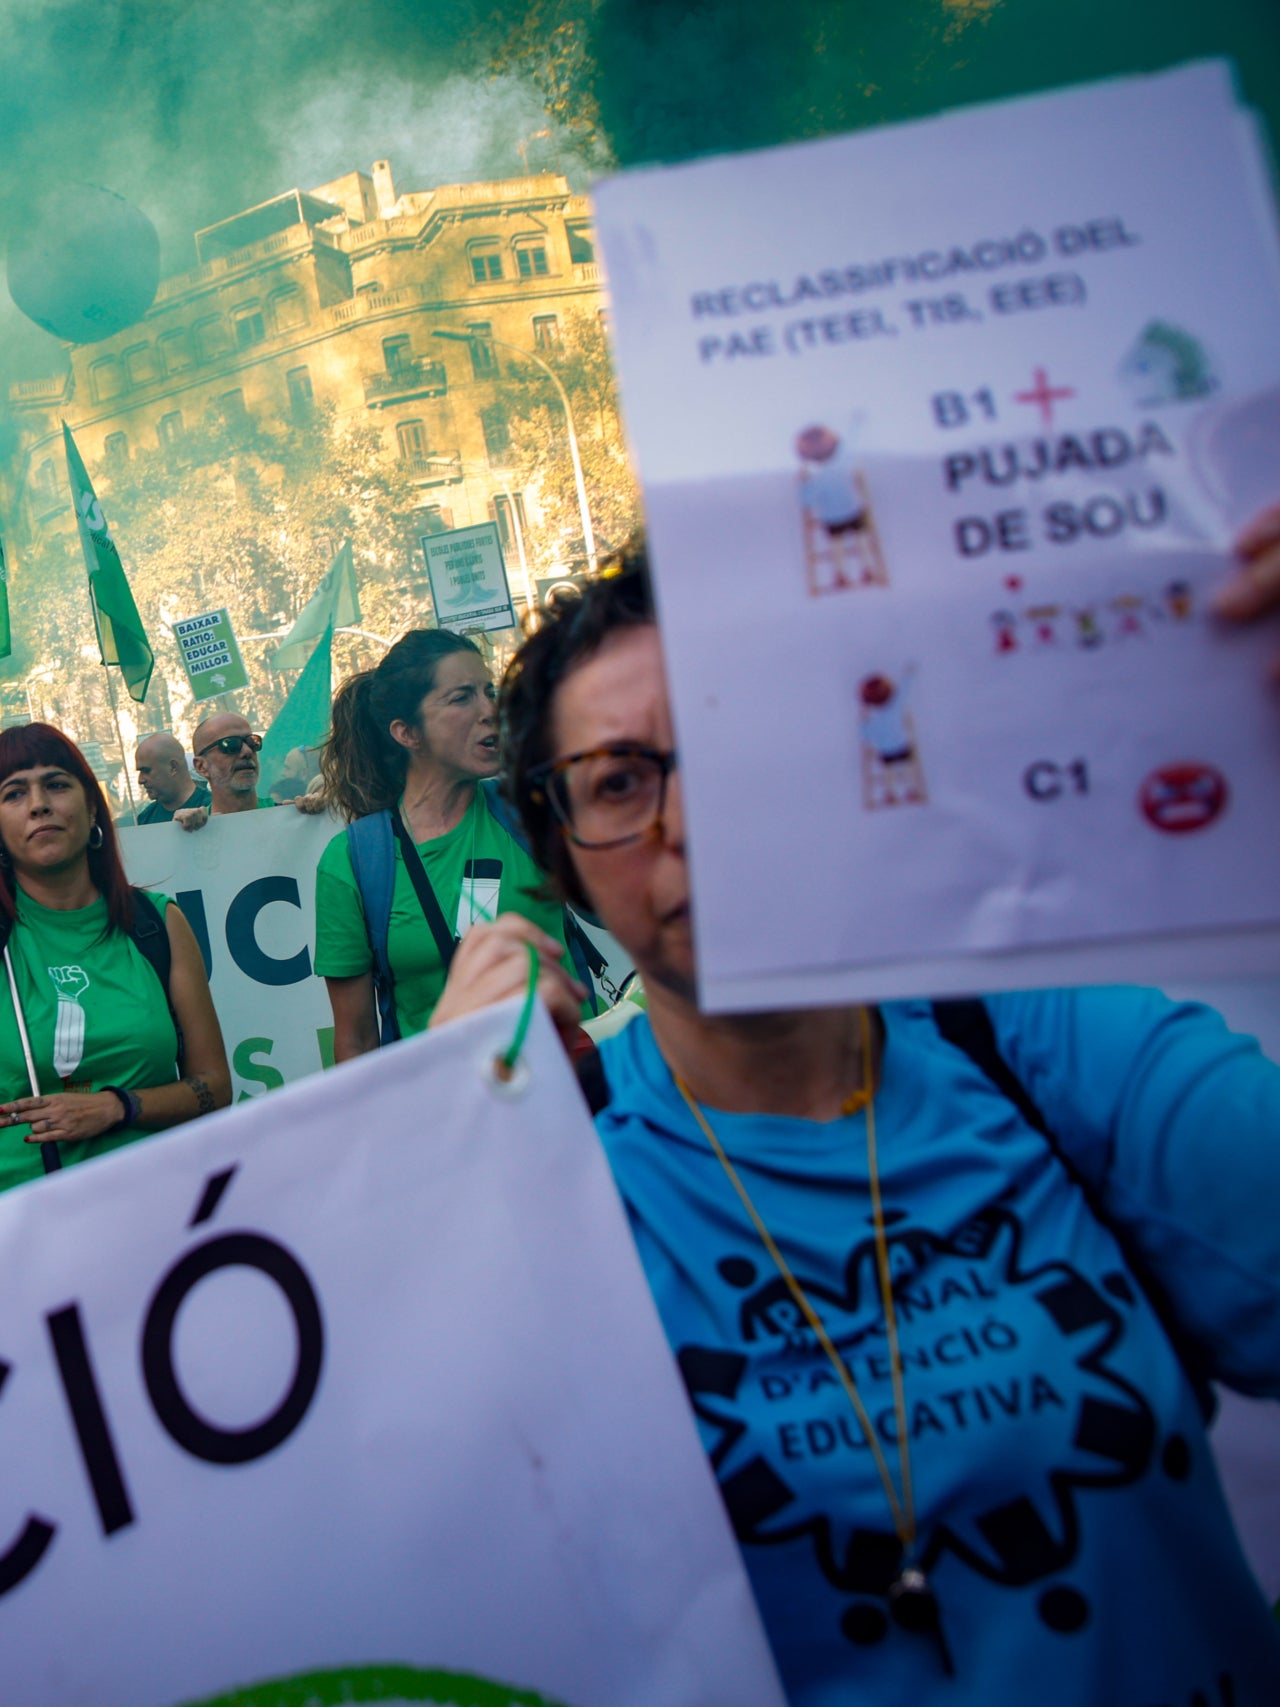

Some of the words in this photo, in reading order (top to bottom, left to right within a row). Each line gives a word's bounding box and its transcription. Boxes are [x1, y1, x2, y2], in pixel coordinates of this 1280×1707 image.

[690, 228, 1047, 320] RECLASSIFICACIÓ
[1052, 216, 1140, 258] DEL
[698, 326, 774, 364] PAE
[988, 270, 1088, 315] EEE)
[930, 384, 998, 430] B1
[943, 420, 1173, 493] PUJADA
[954, 512, 1031, 558] DE
[1045, 485, 1169, 546] SOU
[178, 615, 220, 635] BAIXAR
[182, 632, 214, 648] RATIO:
[186, 641, 227, 660] EDUCAR
[191, 654, 229, 674] MILLOR
[1024, 760, 1090, 801] C1
[777, 1373, 1066, 1463] EDUCATIVA
